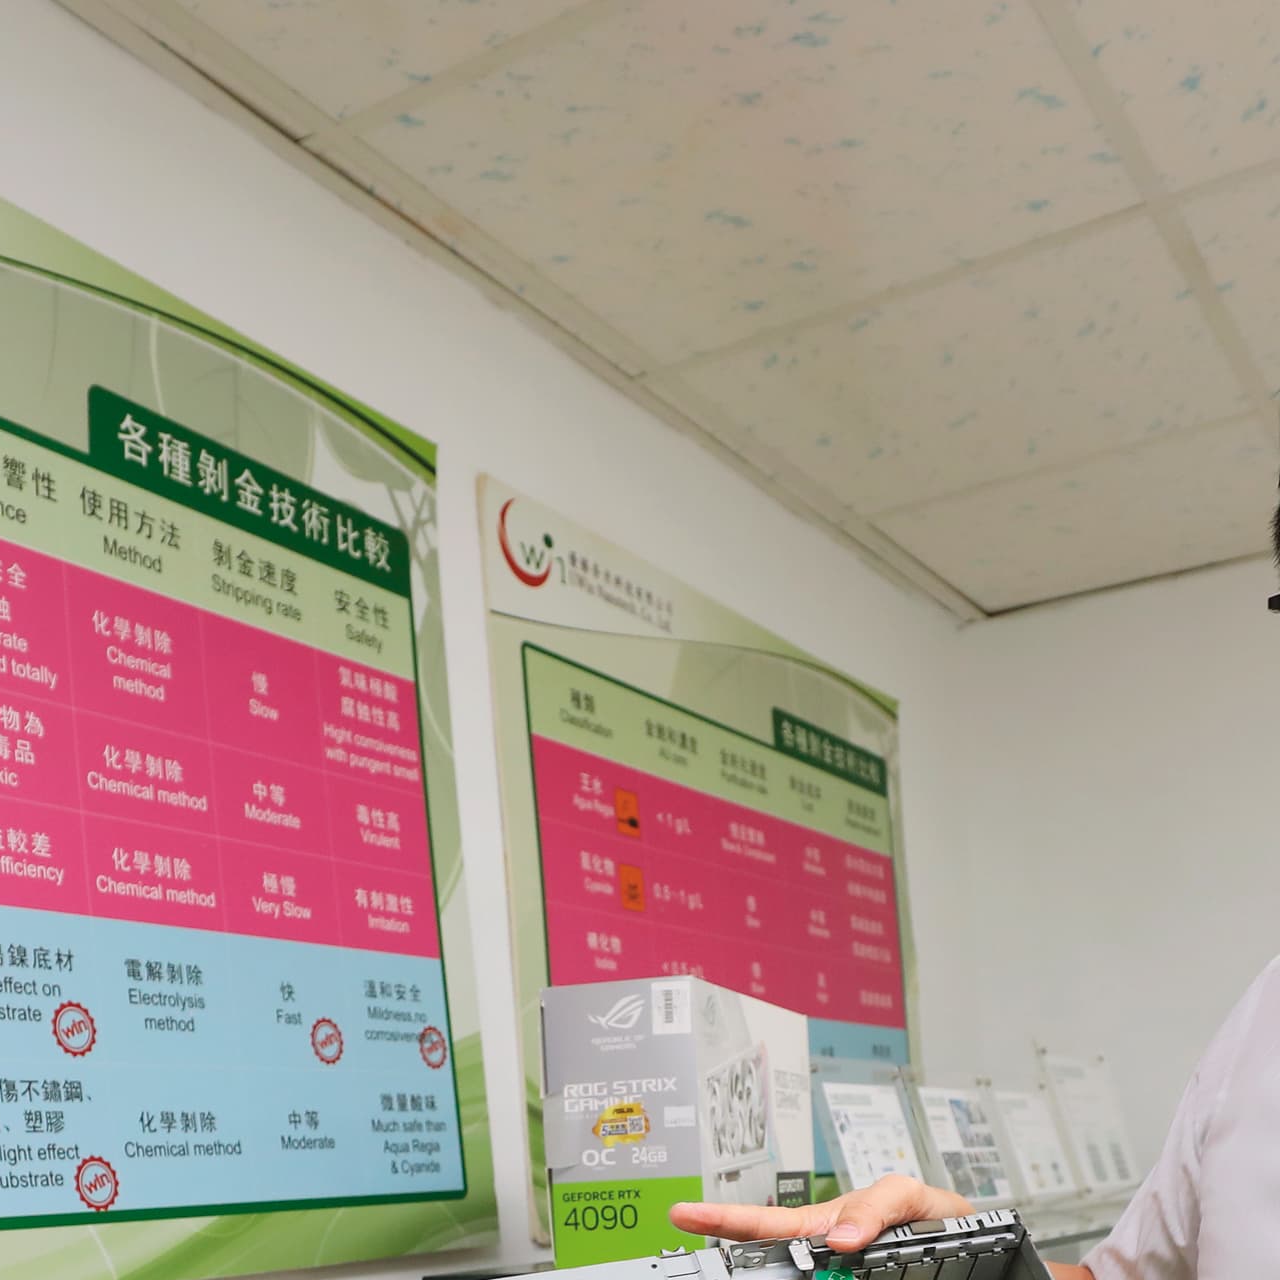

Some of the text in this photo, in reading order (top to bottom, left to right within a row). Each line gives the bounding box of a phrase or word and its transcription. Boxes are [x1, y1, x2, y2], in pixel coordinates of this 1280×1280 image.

[117, 413, 392, 573] 各種剝金技術比較
[80, 485, 181, 551] 使用方法
[103, 536, 163, 574] Method
[211, 573, 303, 622] Stripping rate
[334, 589, 390, 631] 安全性
[92, 609, 173, 655] 化學剝除
[345, 623, 384, 655] Safety
[11, 658, 58, 690] totally
[106, 646, 172, 679] Chemical
[113, 673, 165, 702] method
[249, 698, 279, 721] Slow
[103, 744, 184, 784] 化學剝除
[86, 771, 207, 812] Chemical method
[252, 782, 286, 807] 中等
[244, 803, 302, 829] Moderate
[112, 847, 192, 881] 化學剝除
[96, 875, 215, 910] Chemical method
[252, 896, 312, 920] Very Slow
[124, 958, 204, 986] 電解剝除
[41, 982, 62, 997] on
[128, 988, 206, 1010] Electrolysis
[280, 981, 296, 1003] 快
[144, 1016, 195, 1033] method
[276, 1009, 303, 1026] Fast
[564, 1077, 677, 1098] ROG STRIX
[139, 1111, 217, 1133] 化學剝除
[288, 1110, 320, 1130] 中等
[37, 1143, 80, 1161] effect
[124, 1140, 243, 1159] Chemical method
[280, 1135, 335, 1151] Moderate
[582, 1149, 616, 1166] OC
[563, 1189, 641, 1202] GEFORCE RTX
[564, 1204, 638, 1231] 4090
